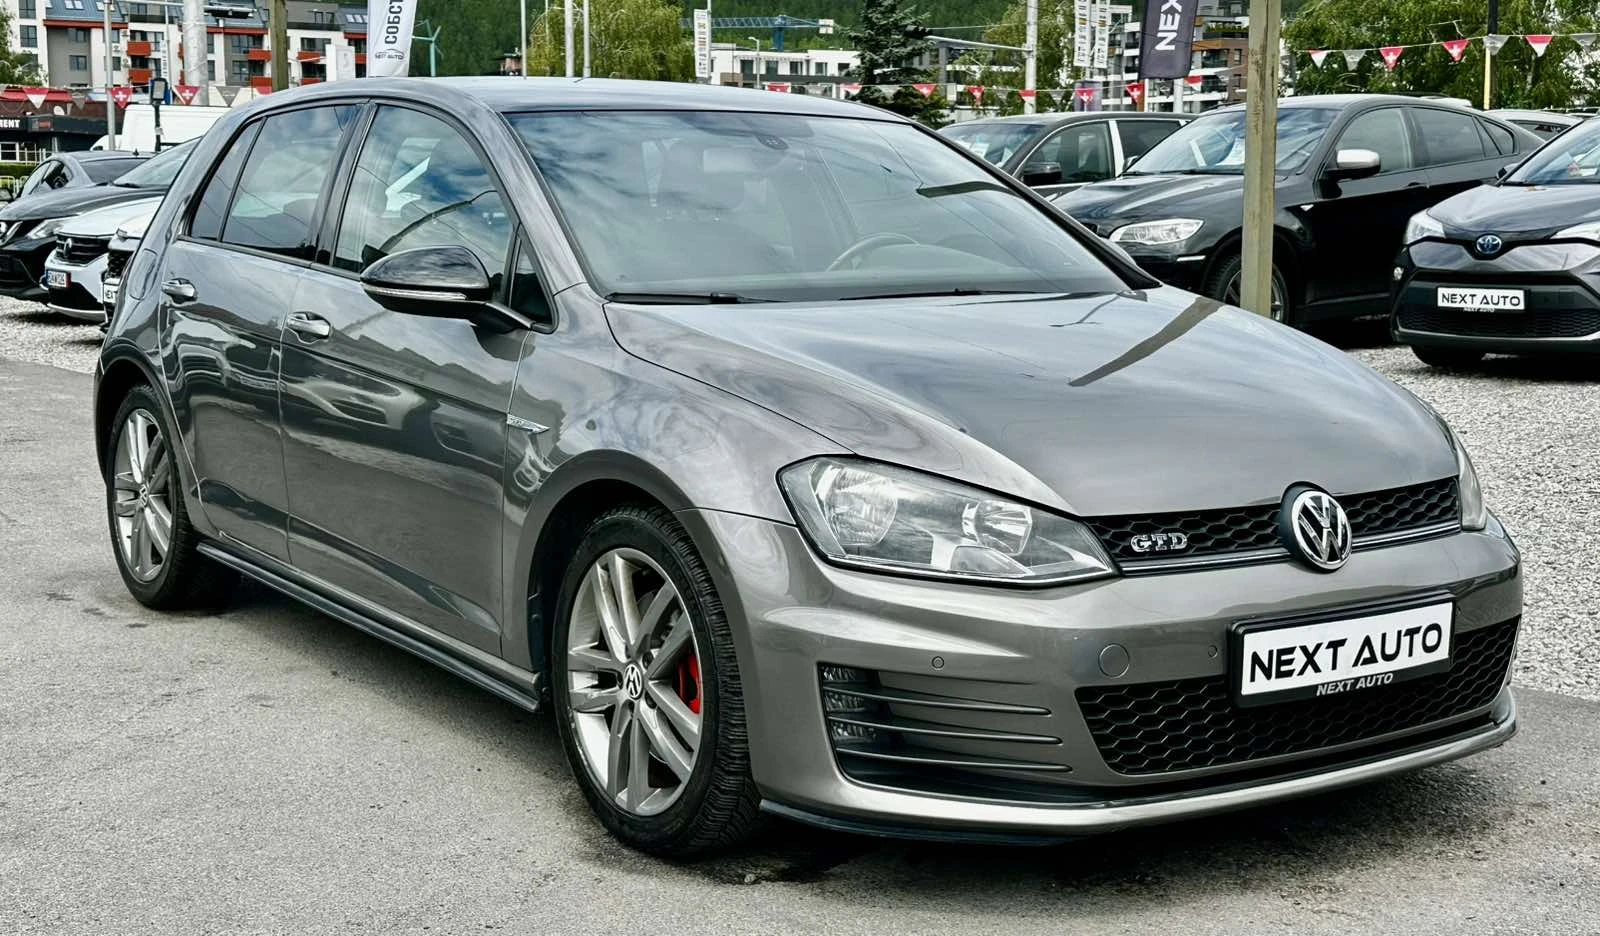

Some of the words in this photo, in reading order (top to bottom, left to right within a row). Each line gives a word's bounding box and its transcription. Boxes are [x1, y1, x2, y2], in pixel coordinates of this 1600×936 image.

[1441, 293, 1477, 304] NEXT
[1480, 294, 1521, 306] AUTO
[1131, 532, 1188, 552] GTD
[1250, 638, 1348, 682] NEXT
[1352, 623, 1442, 667] AUTO
[1316, 678, 1357, 697] NEXT
[1356, 673, 1394, 688] AUTO
